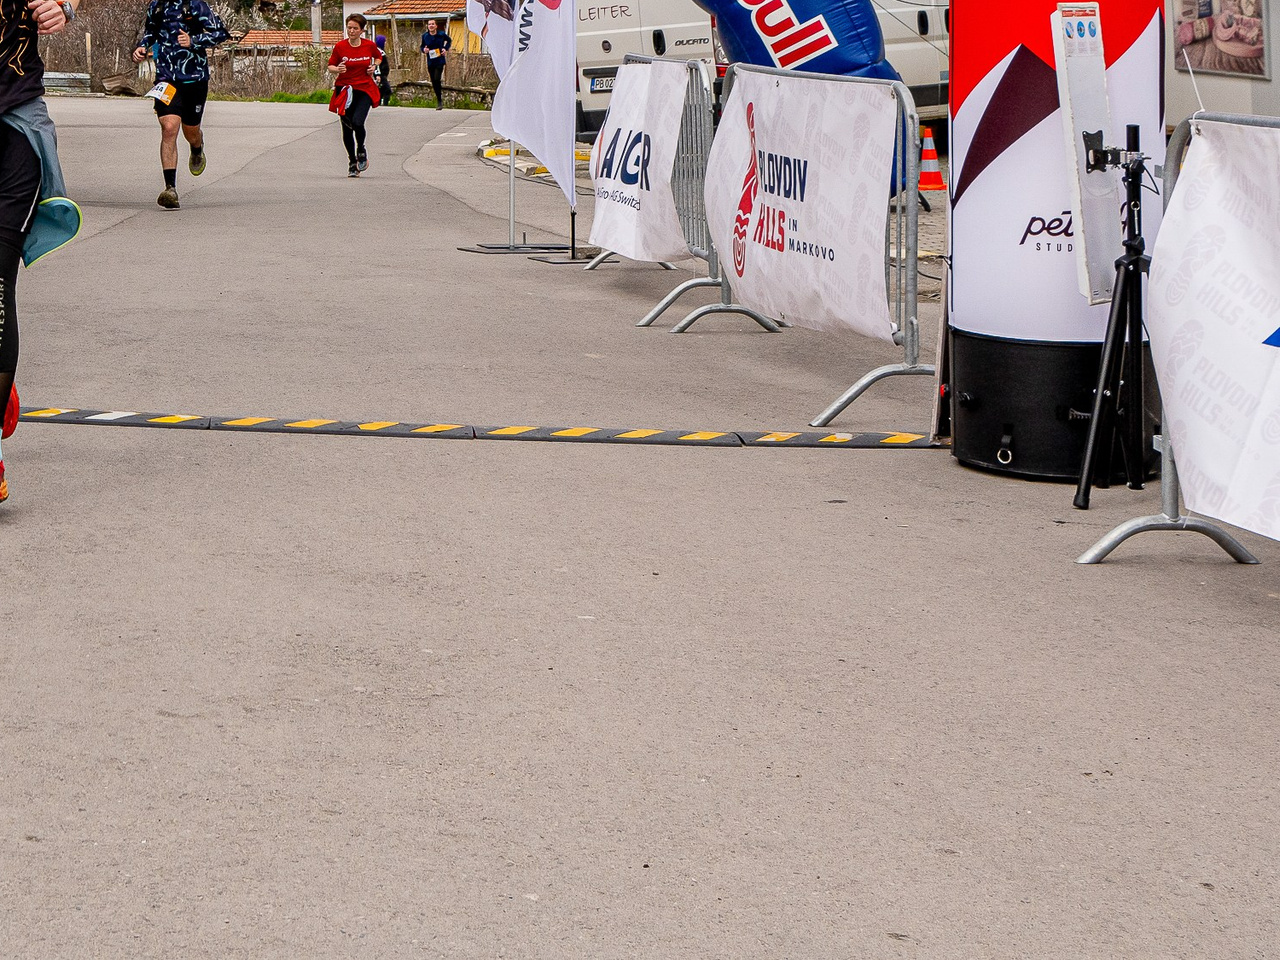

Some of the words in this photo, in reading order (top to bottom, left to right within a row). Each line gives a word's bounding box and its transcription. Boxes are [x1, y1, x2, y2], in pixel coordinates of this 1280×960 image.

[578, 4, 633, 22] LEITER
[674, 37, 710, 47] DUCATO
[758, 150, 808, 202] PLOVDIV
[788, 218, 798, 232] IN
[788, 238, 835, 262] MARKOVO
[1036, 242, 1074, 253] STUD
